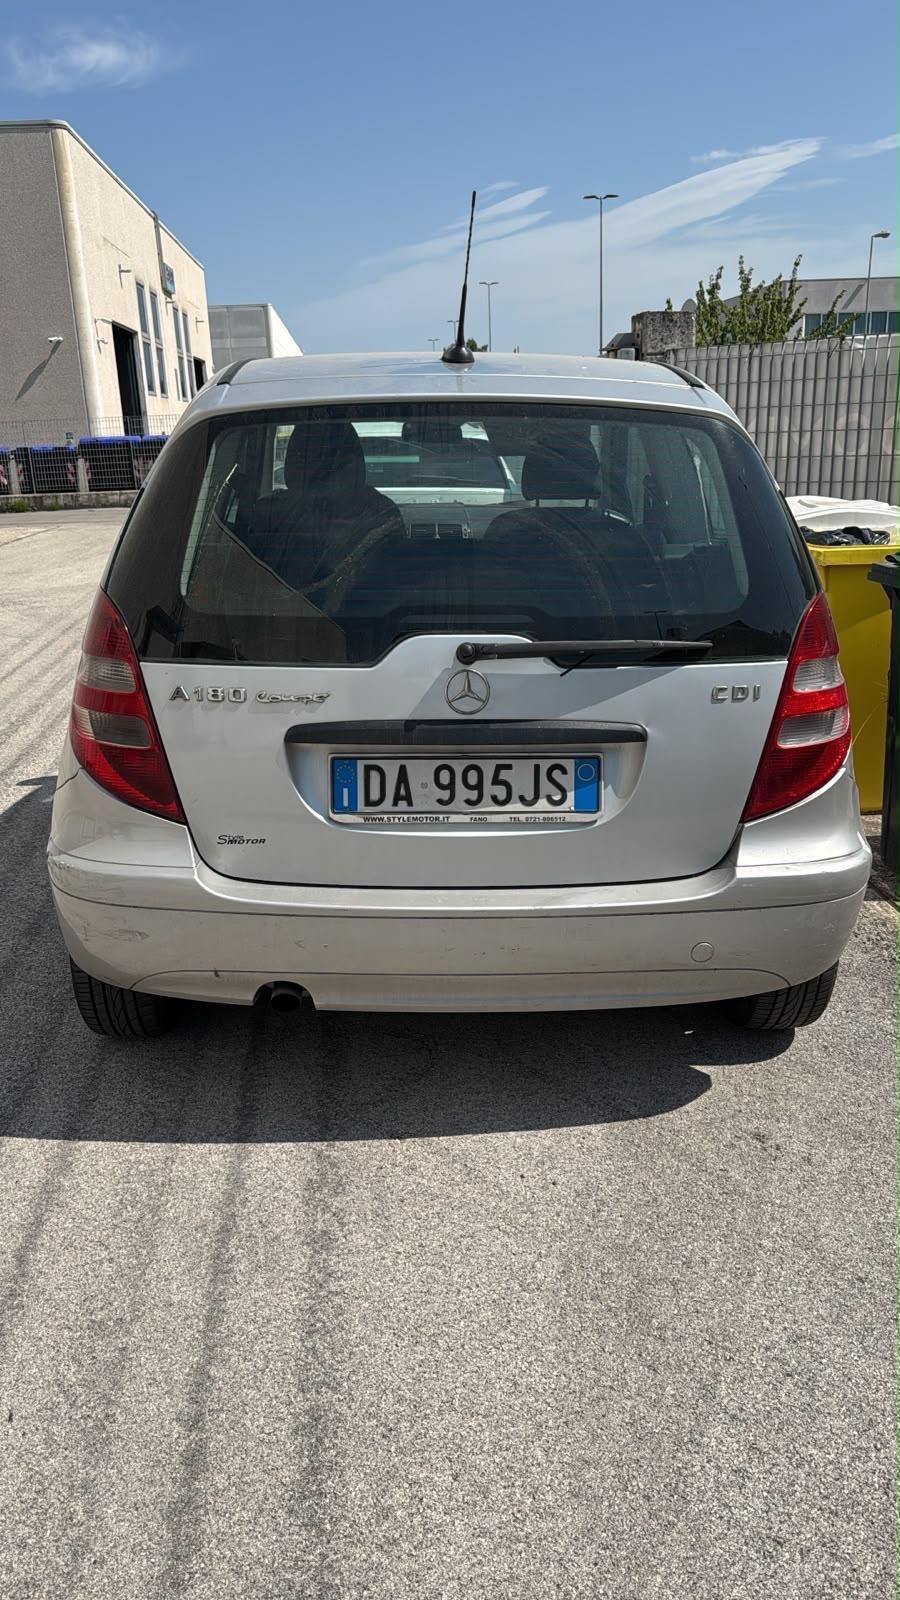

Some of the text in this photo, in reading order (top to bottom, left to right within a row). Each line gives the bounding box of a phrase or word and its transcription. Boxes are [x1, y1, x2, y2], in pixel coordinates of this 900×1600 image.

[711, 684, 761, 702] CDI
[363, 764, 414, 807] DA
[433, 763, 568, 807] 995JS
[363, 815, 450, 823] WWW.STYLEMOTOR.IT
